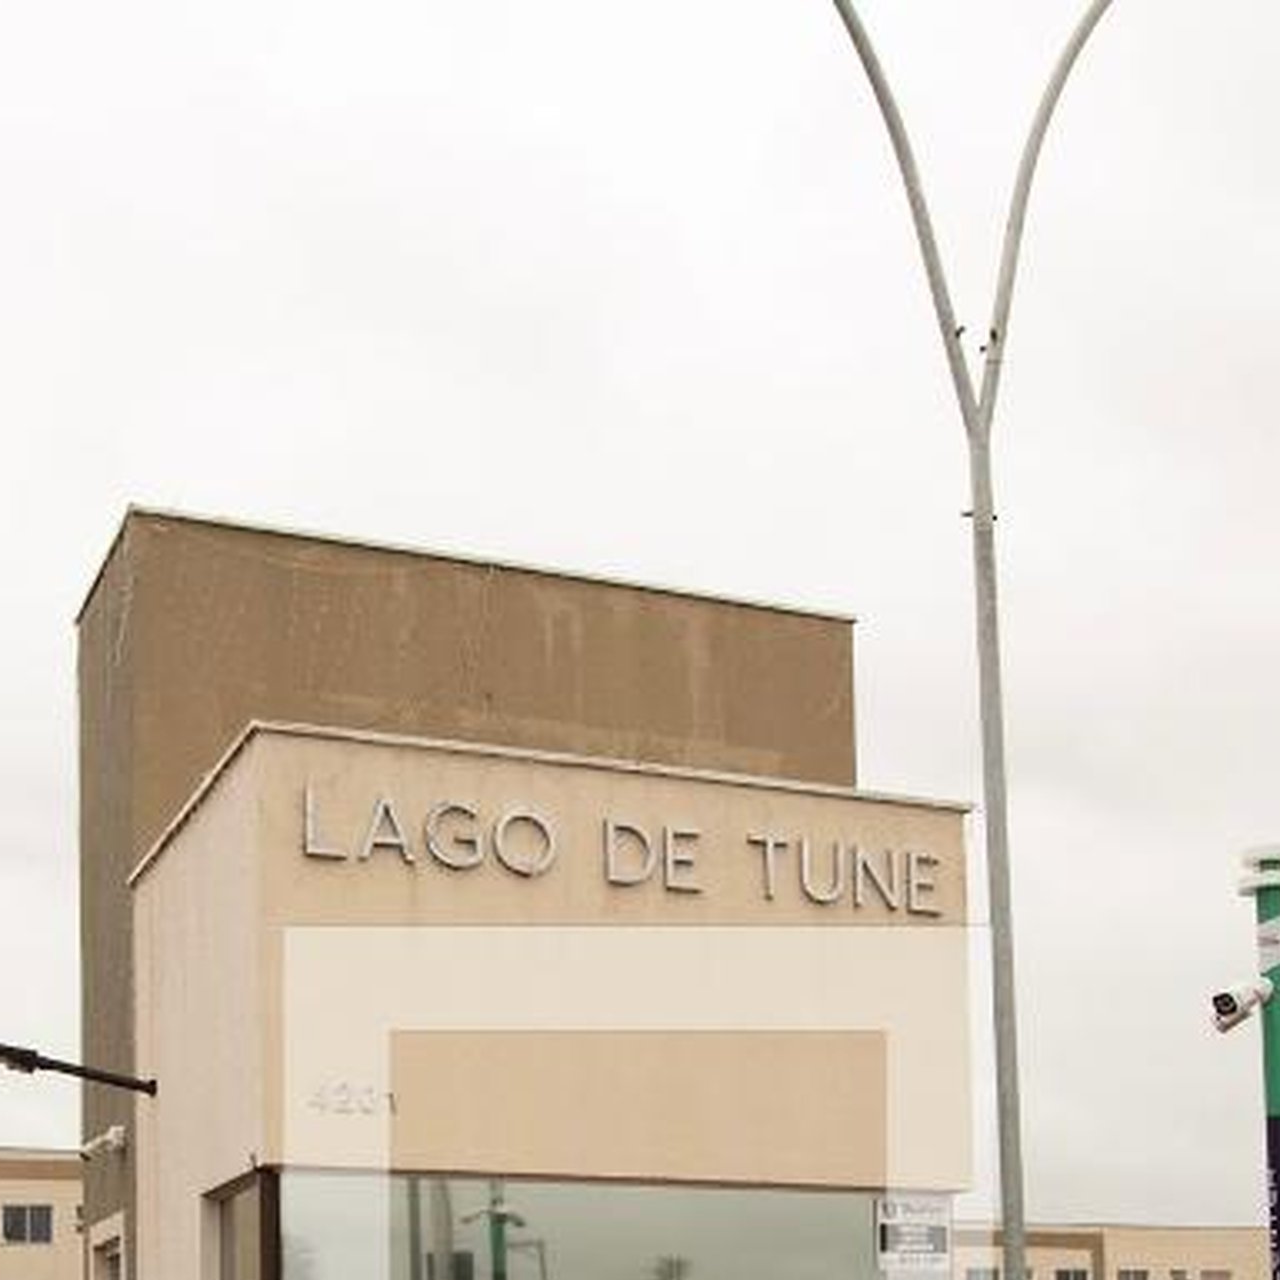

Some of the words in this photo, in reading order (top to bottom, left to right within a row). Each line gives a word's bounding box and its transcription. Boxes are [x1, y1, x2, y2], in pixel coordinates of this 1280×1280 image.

[303, 778, 557, 877] LAGO
[603, 817, 703, 895] DE
[746, 830, 942, 918] TUNE
